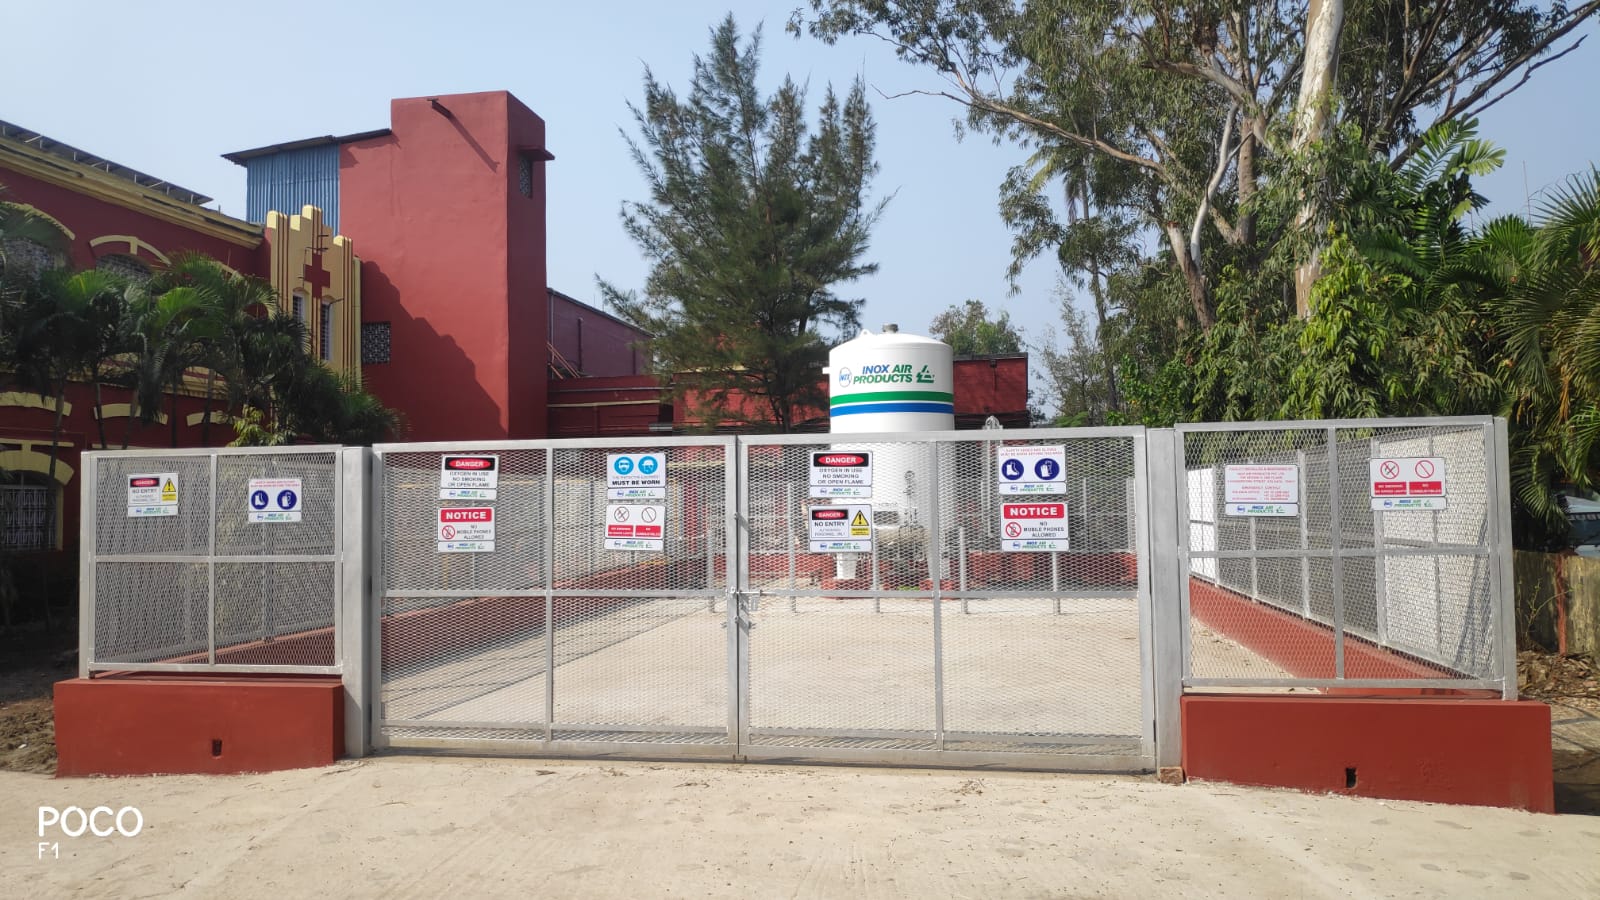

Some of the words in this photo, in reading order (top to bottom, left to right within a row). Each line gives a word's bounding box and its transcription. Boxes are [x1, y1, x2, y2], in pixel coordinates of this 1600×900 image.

[862, 365, 890, 374] INOX
[892, 364, 912, 373] AIR
[853, 374, 913, 384] PRODUCTS
[1010, 507, 1058, 516] NOTICE
